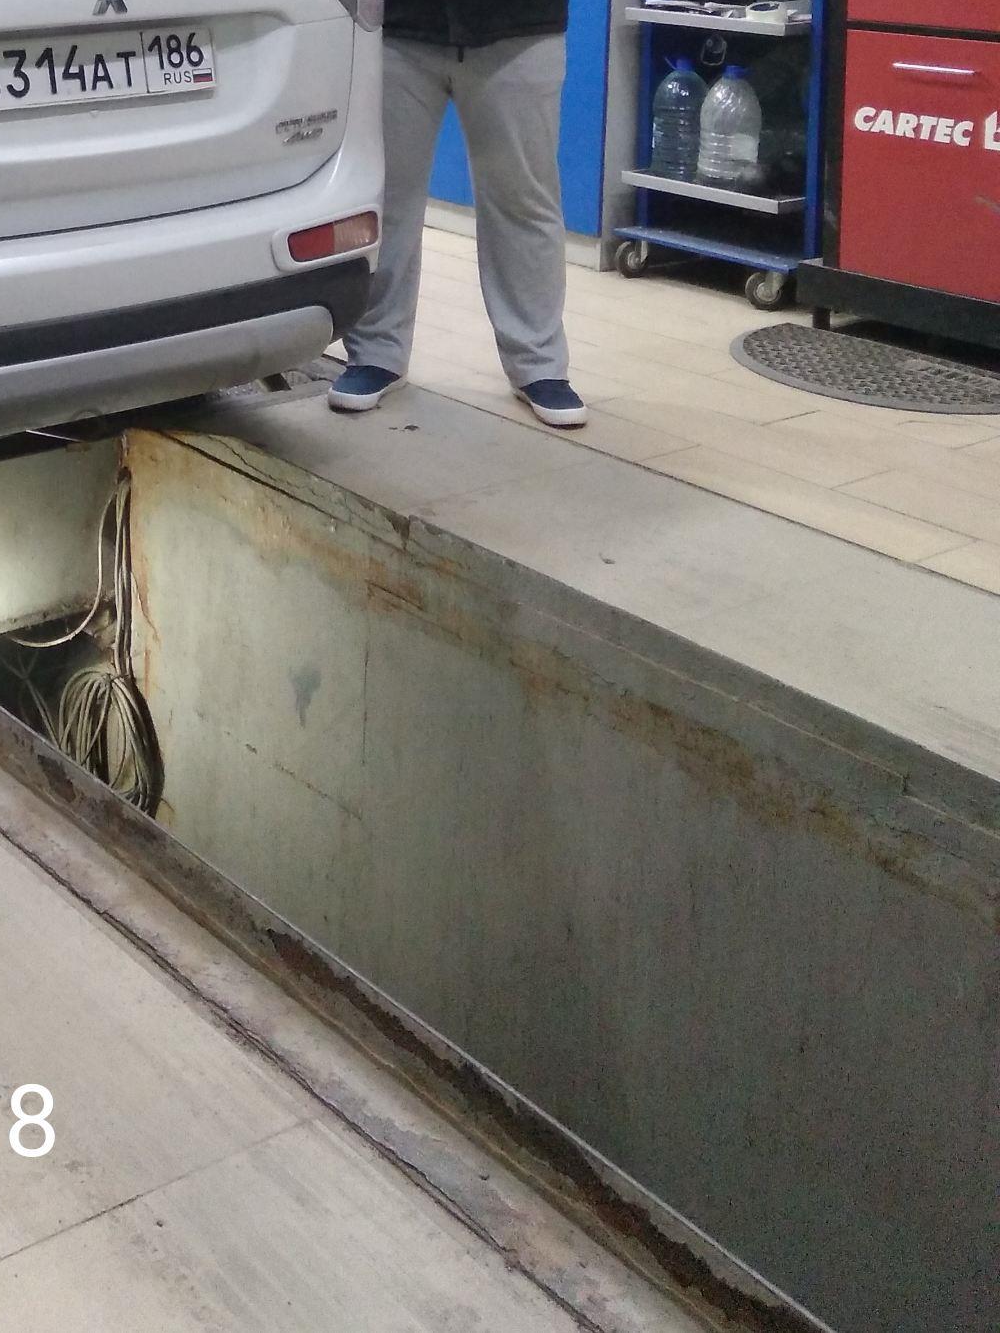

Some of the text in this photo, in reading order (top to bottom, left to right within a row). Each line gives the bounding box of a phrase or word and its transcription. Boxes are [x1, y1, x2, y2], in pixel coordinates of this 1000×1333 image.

[147, 32, 204, 70] 186
[164, 71, 193, 85] RUS
[854, 106, 975, 147] CARTEC
